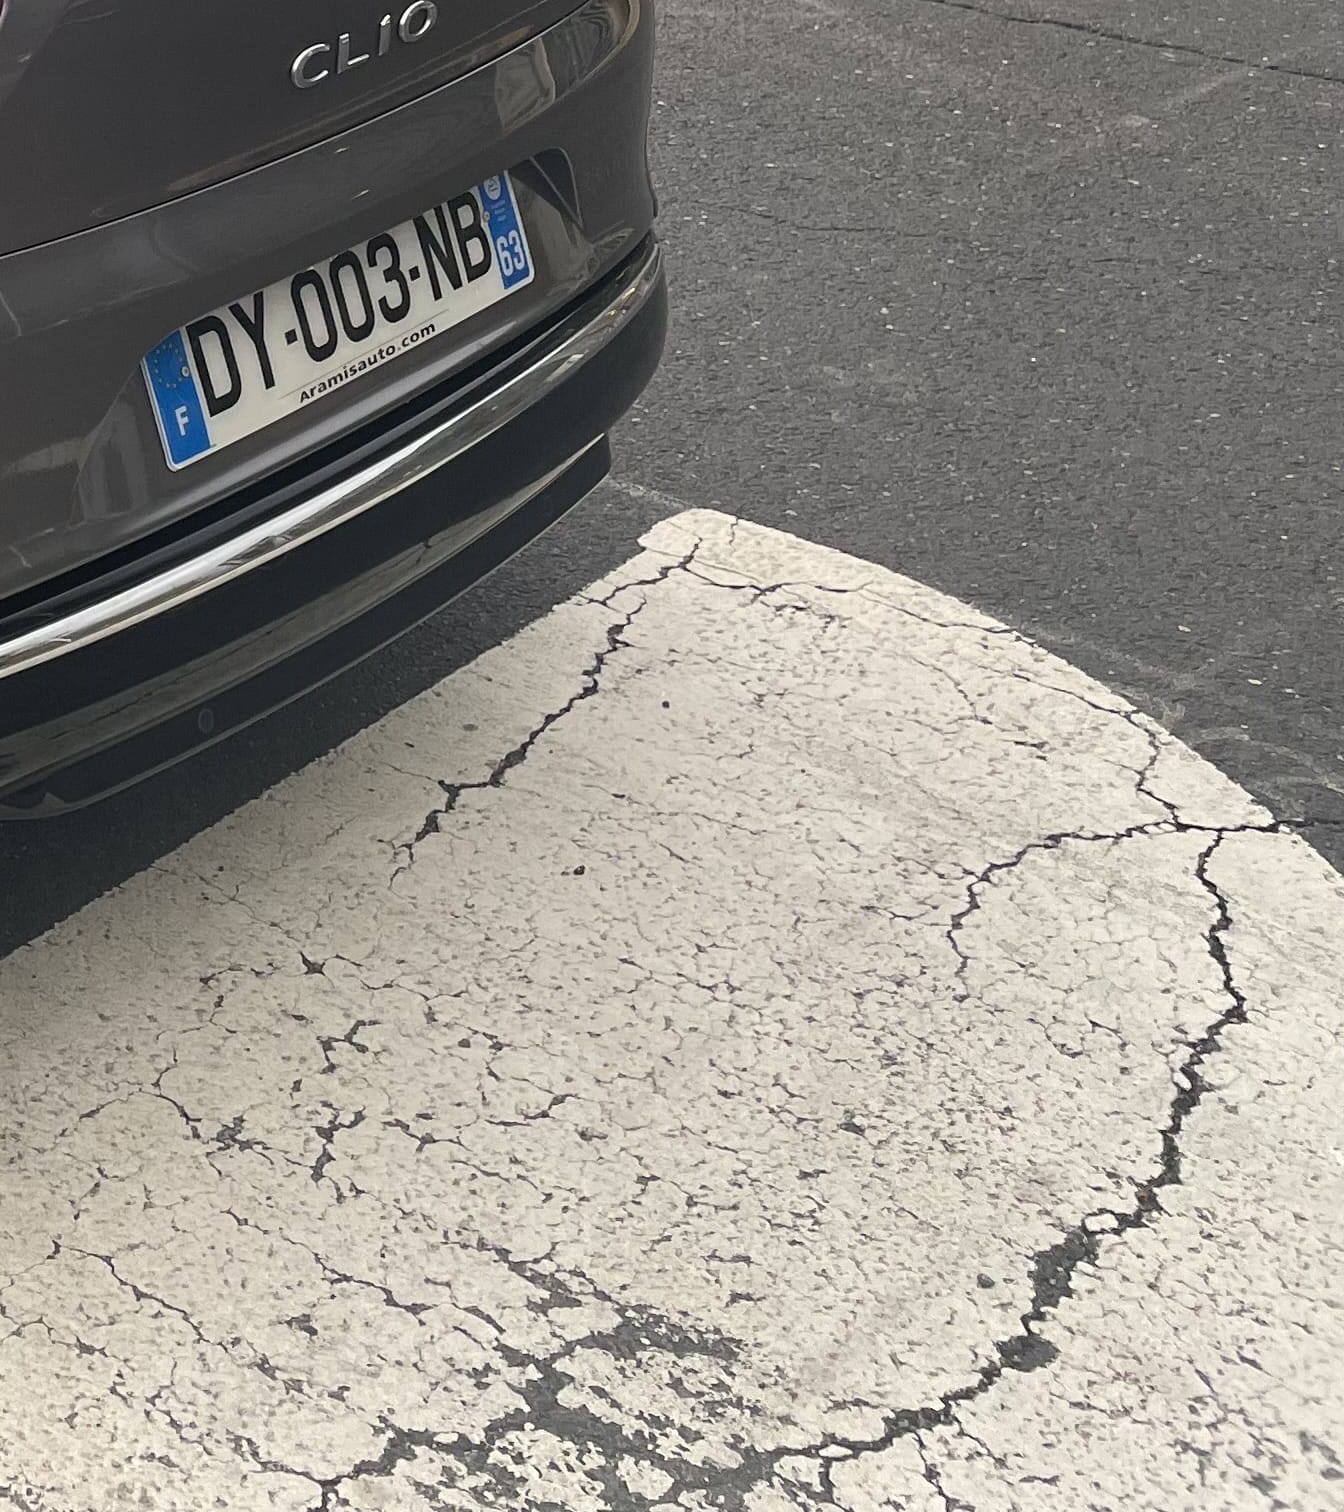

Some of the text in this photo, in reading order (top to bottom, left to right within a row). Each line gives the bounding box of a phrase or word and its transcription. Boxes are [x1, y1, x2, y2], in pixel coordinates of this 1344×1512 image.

[291, 0, 438, 89] CLIO
[496, 229, 525, 277] 63
[185, 191, 492, 418] DY-003-NB
[299, 321, 436, 404] Aramisauto.com
[174, 405, 190, 437] F
